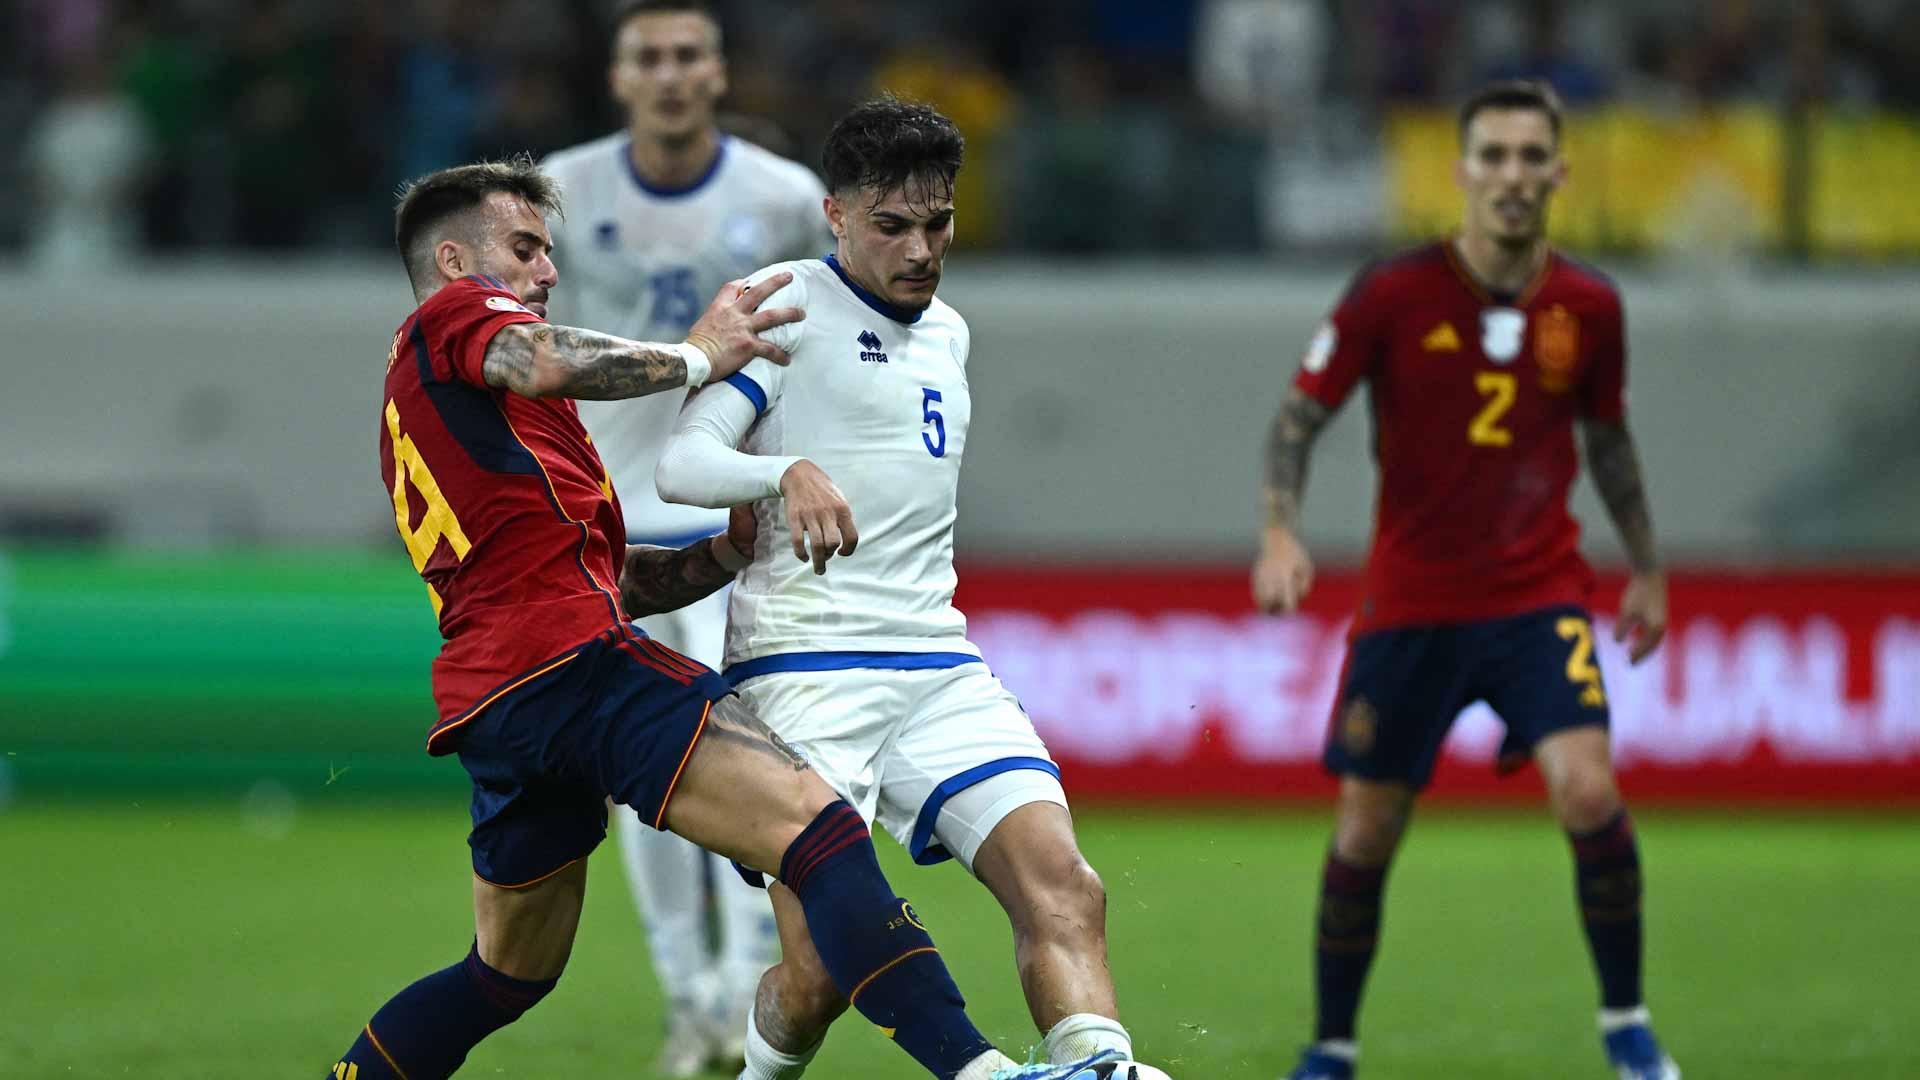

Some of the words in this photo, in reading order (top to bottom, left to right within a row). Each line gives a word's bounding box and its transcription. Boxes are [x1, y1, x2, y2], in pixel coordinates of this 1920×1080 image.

[921, 387, 946, 459] 5
[1467, 372, 1518, 447] 2
[1555, 617, 1601, 685] 2
